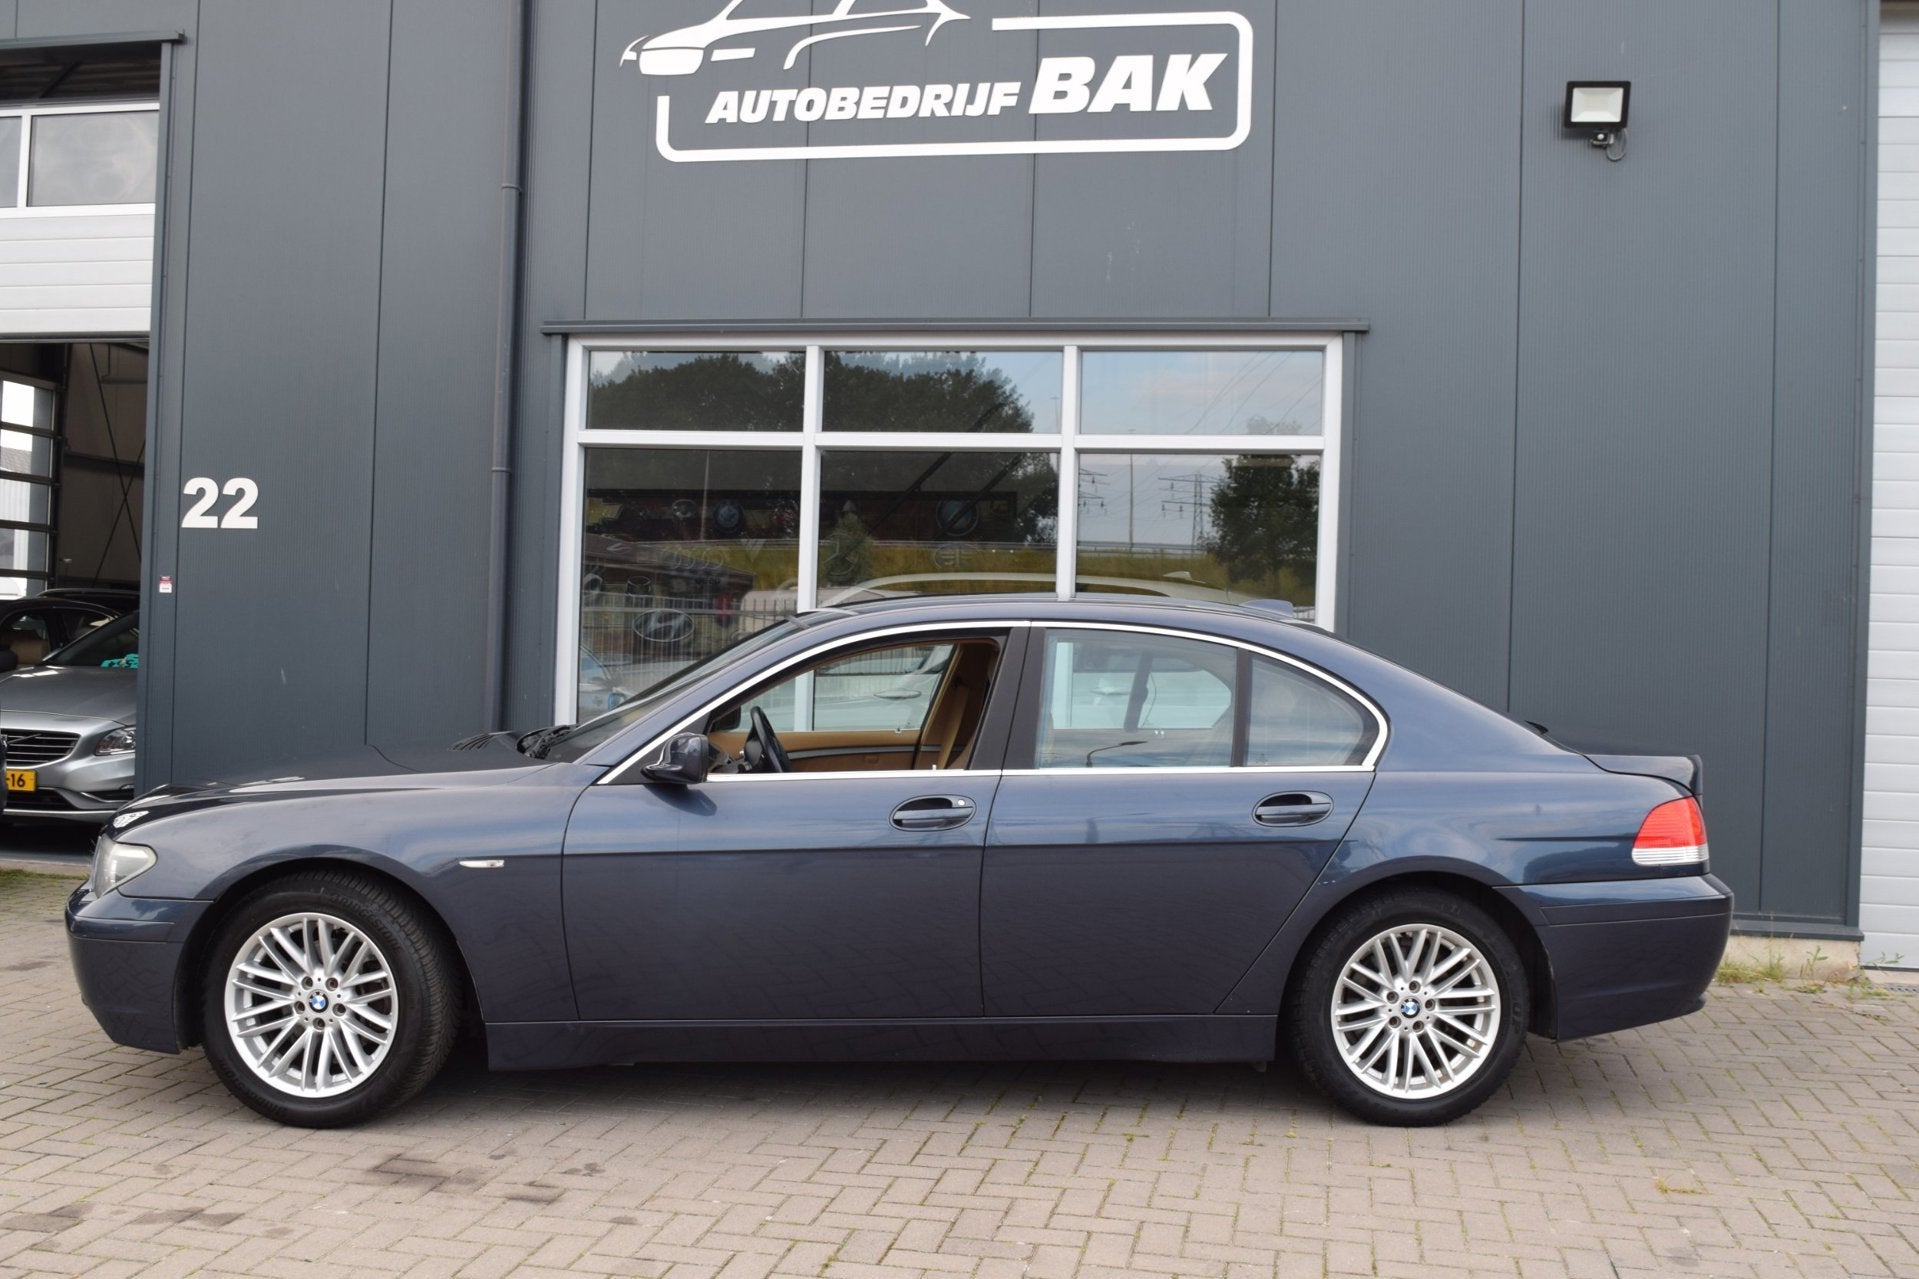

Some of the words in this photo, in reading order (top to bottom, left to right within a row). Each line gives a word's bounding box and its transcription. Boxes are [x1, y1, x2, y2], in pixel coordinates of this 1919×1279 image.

[704, 82, 1022, 124] AUTOBEDRIJF
[1028, 53, 1228, 114] BAK
[181, 477, 259, 529] 22
